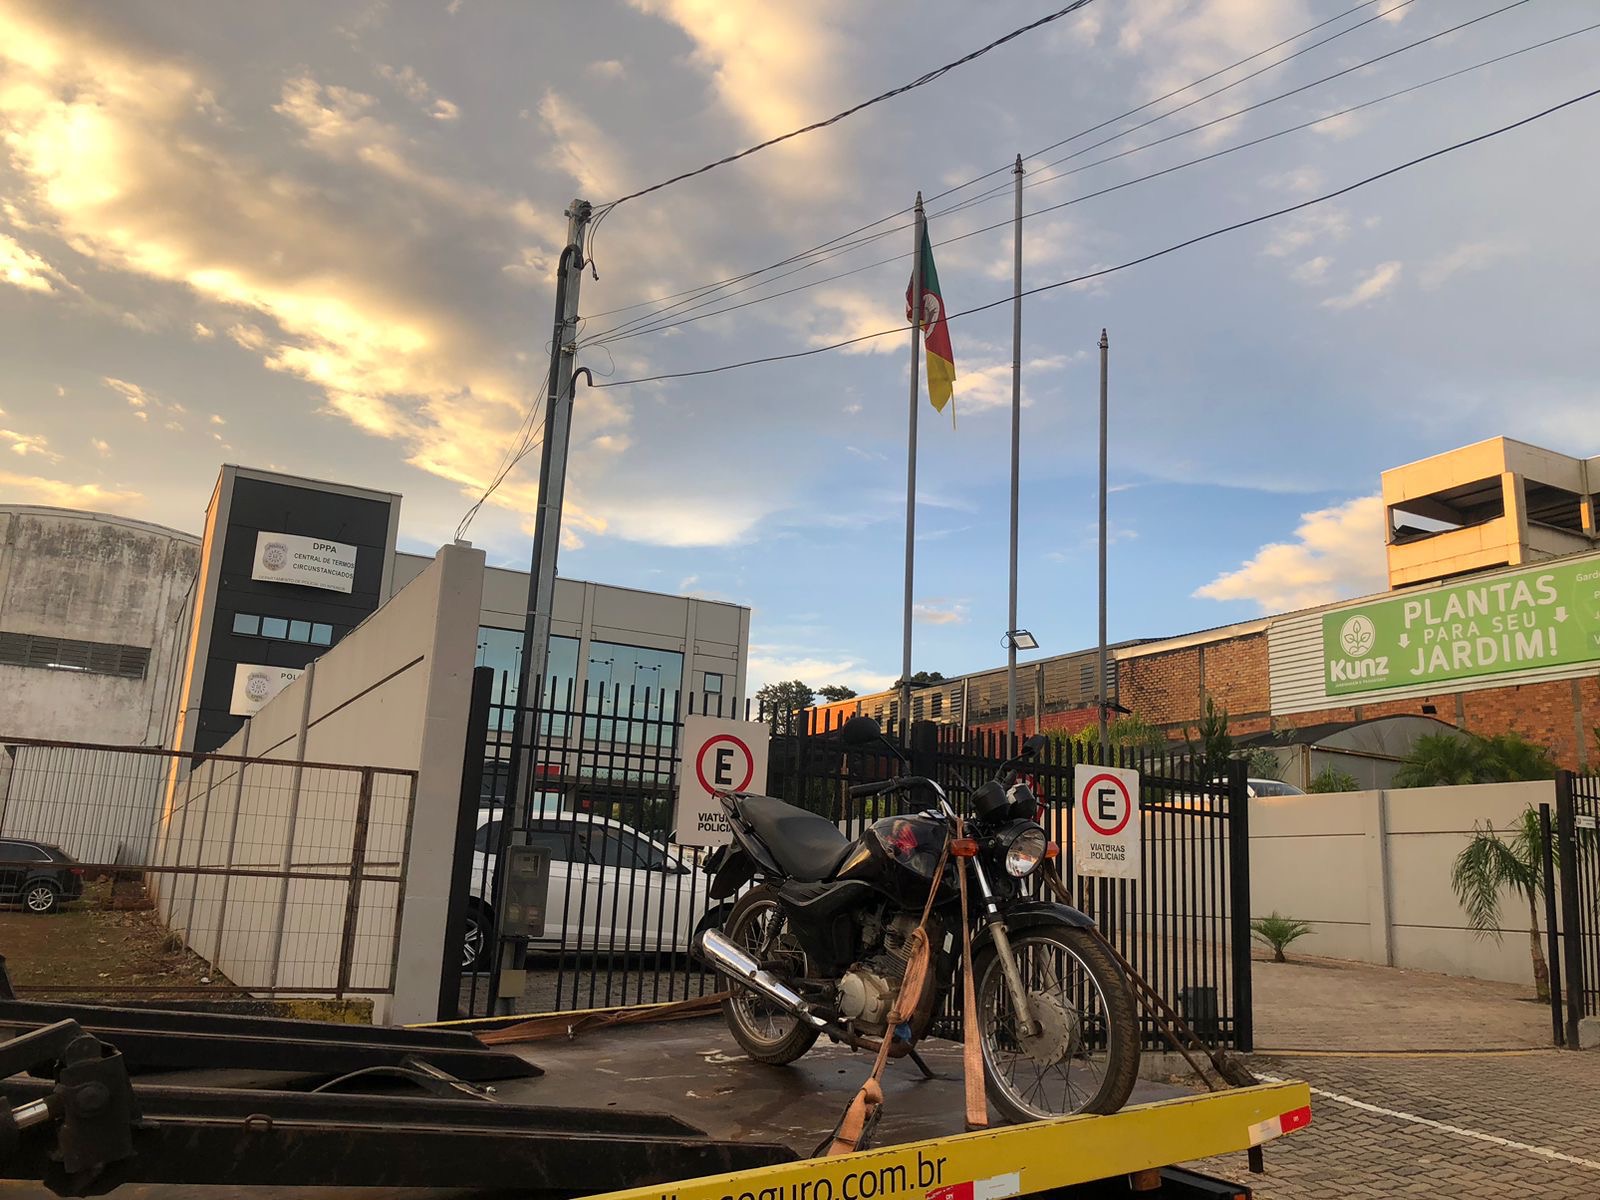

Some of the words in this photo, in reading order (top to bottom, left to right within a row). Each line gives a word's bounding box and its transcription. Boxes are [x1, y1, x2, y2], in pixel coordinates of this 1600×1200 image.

[313, 542, 337, 554] DPPA
[292, 563, 354, 579] CIRCUNSTANCIADOS
[294, 552, 322, 563] CENTRAL
[332, 559, 355, 569] TERMOS
[1576, 570, 1600, 581] Gard
[1404, 575, 1558, 629] PLANTAS
[1424, 621, 1480, 644] PARA
[1492, 610, 1536, 633] SEU
[1410, 626, 1558, 675] JARDIM!
[1330, 656, 1390, 682] Kunz
[715, 748, 734, 785] E
[1098, 789, 1117, 820] E
[1090, 843, 1126, 853] VIATURAS
[1090, 852, 1126, 861] POLICIAIS
